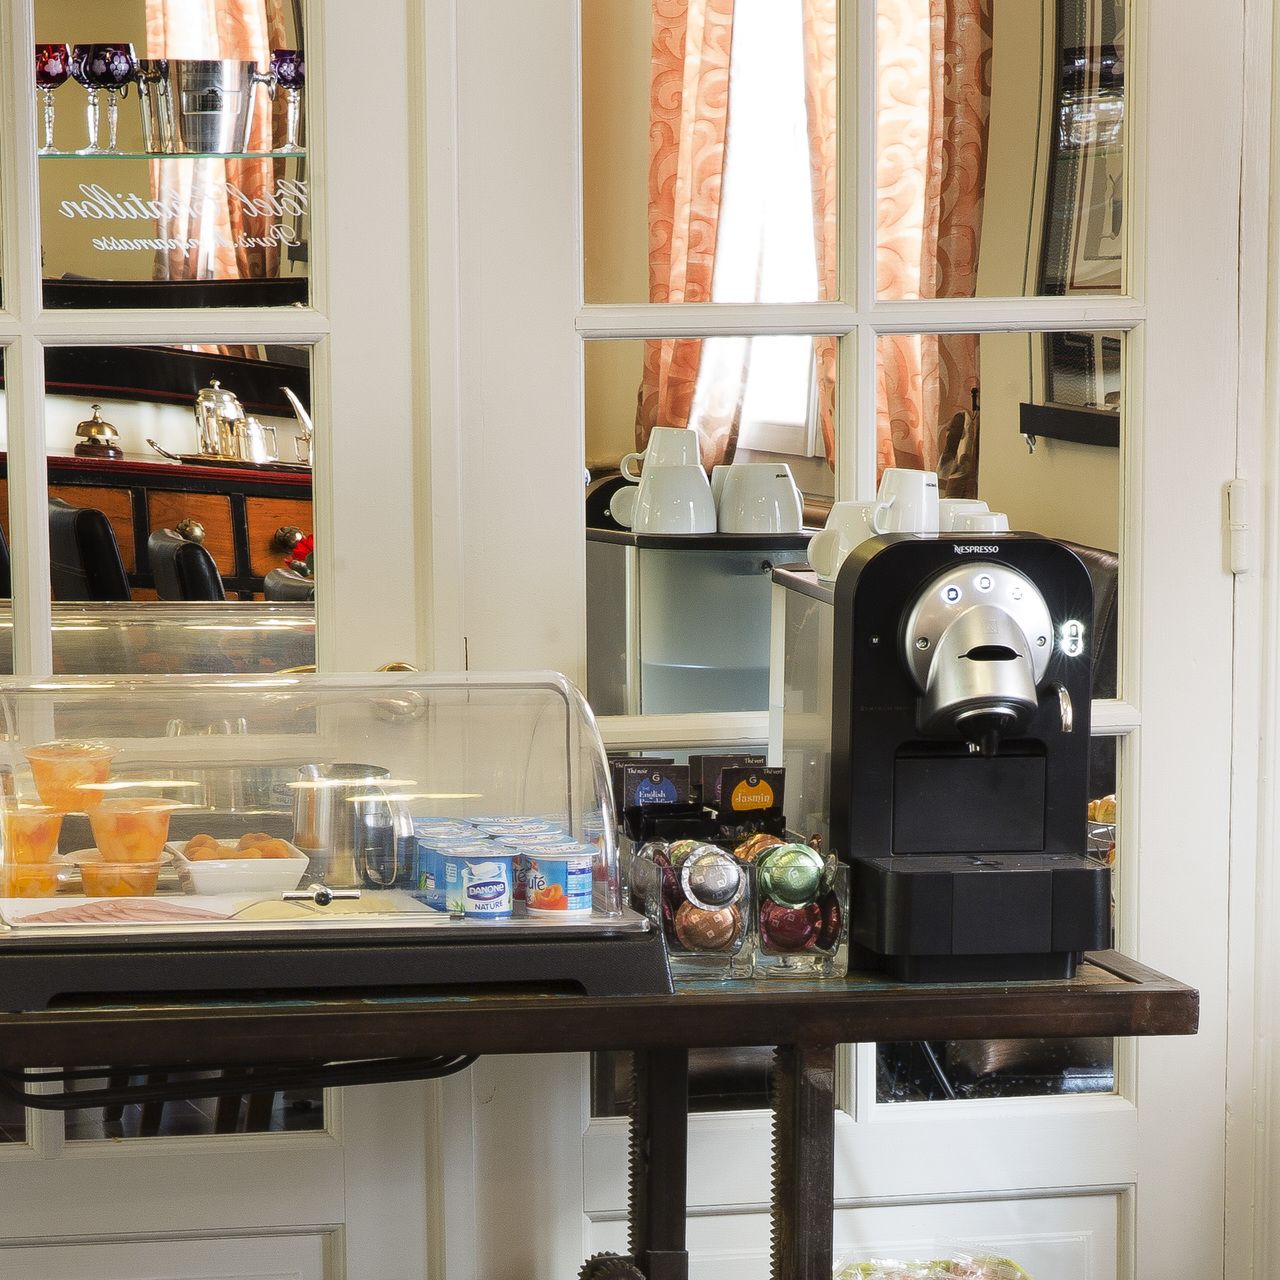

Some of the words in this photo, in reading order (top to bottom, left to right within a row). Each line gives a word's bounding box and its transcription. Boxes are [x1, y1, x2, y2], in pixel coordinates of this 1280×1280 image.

[953, 544, 1000, 554] NESPRESSO
[639, 790, 666, 800] English
[736, 793, 770, 803] Jasmin
[475, 900, 503, 911] NATURE
